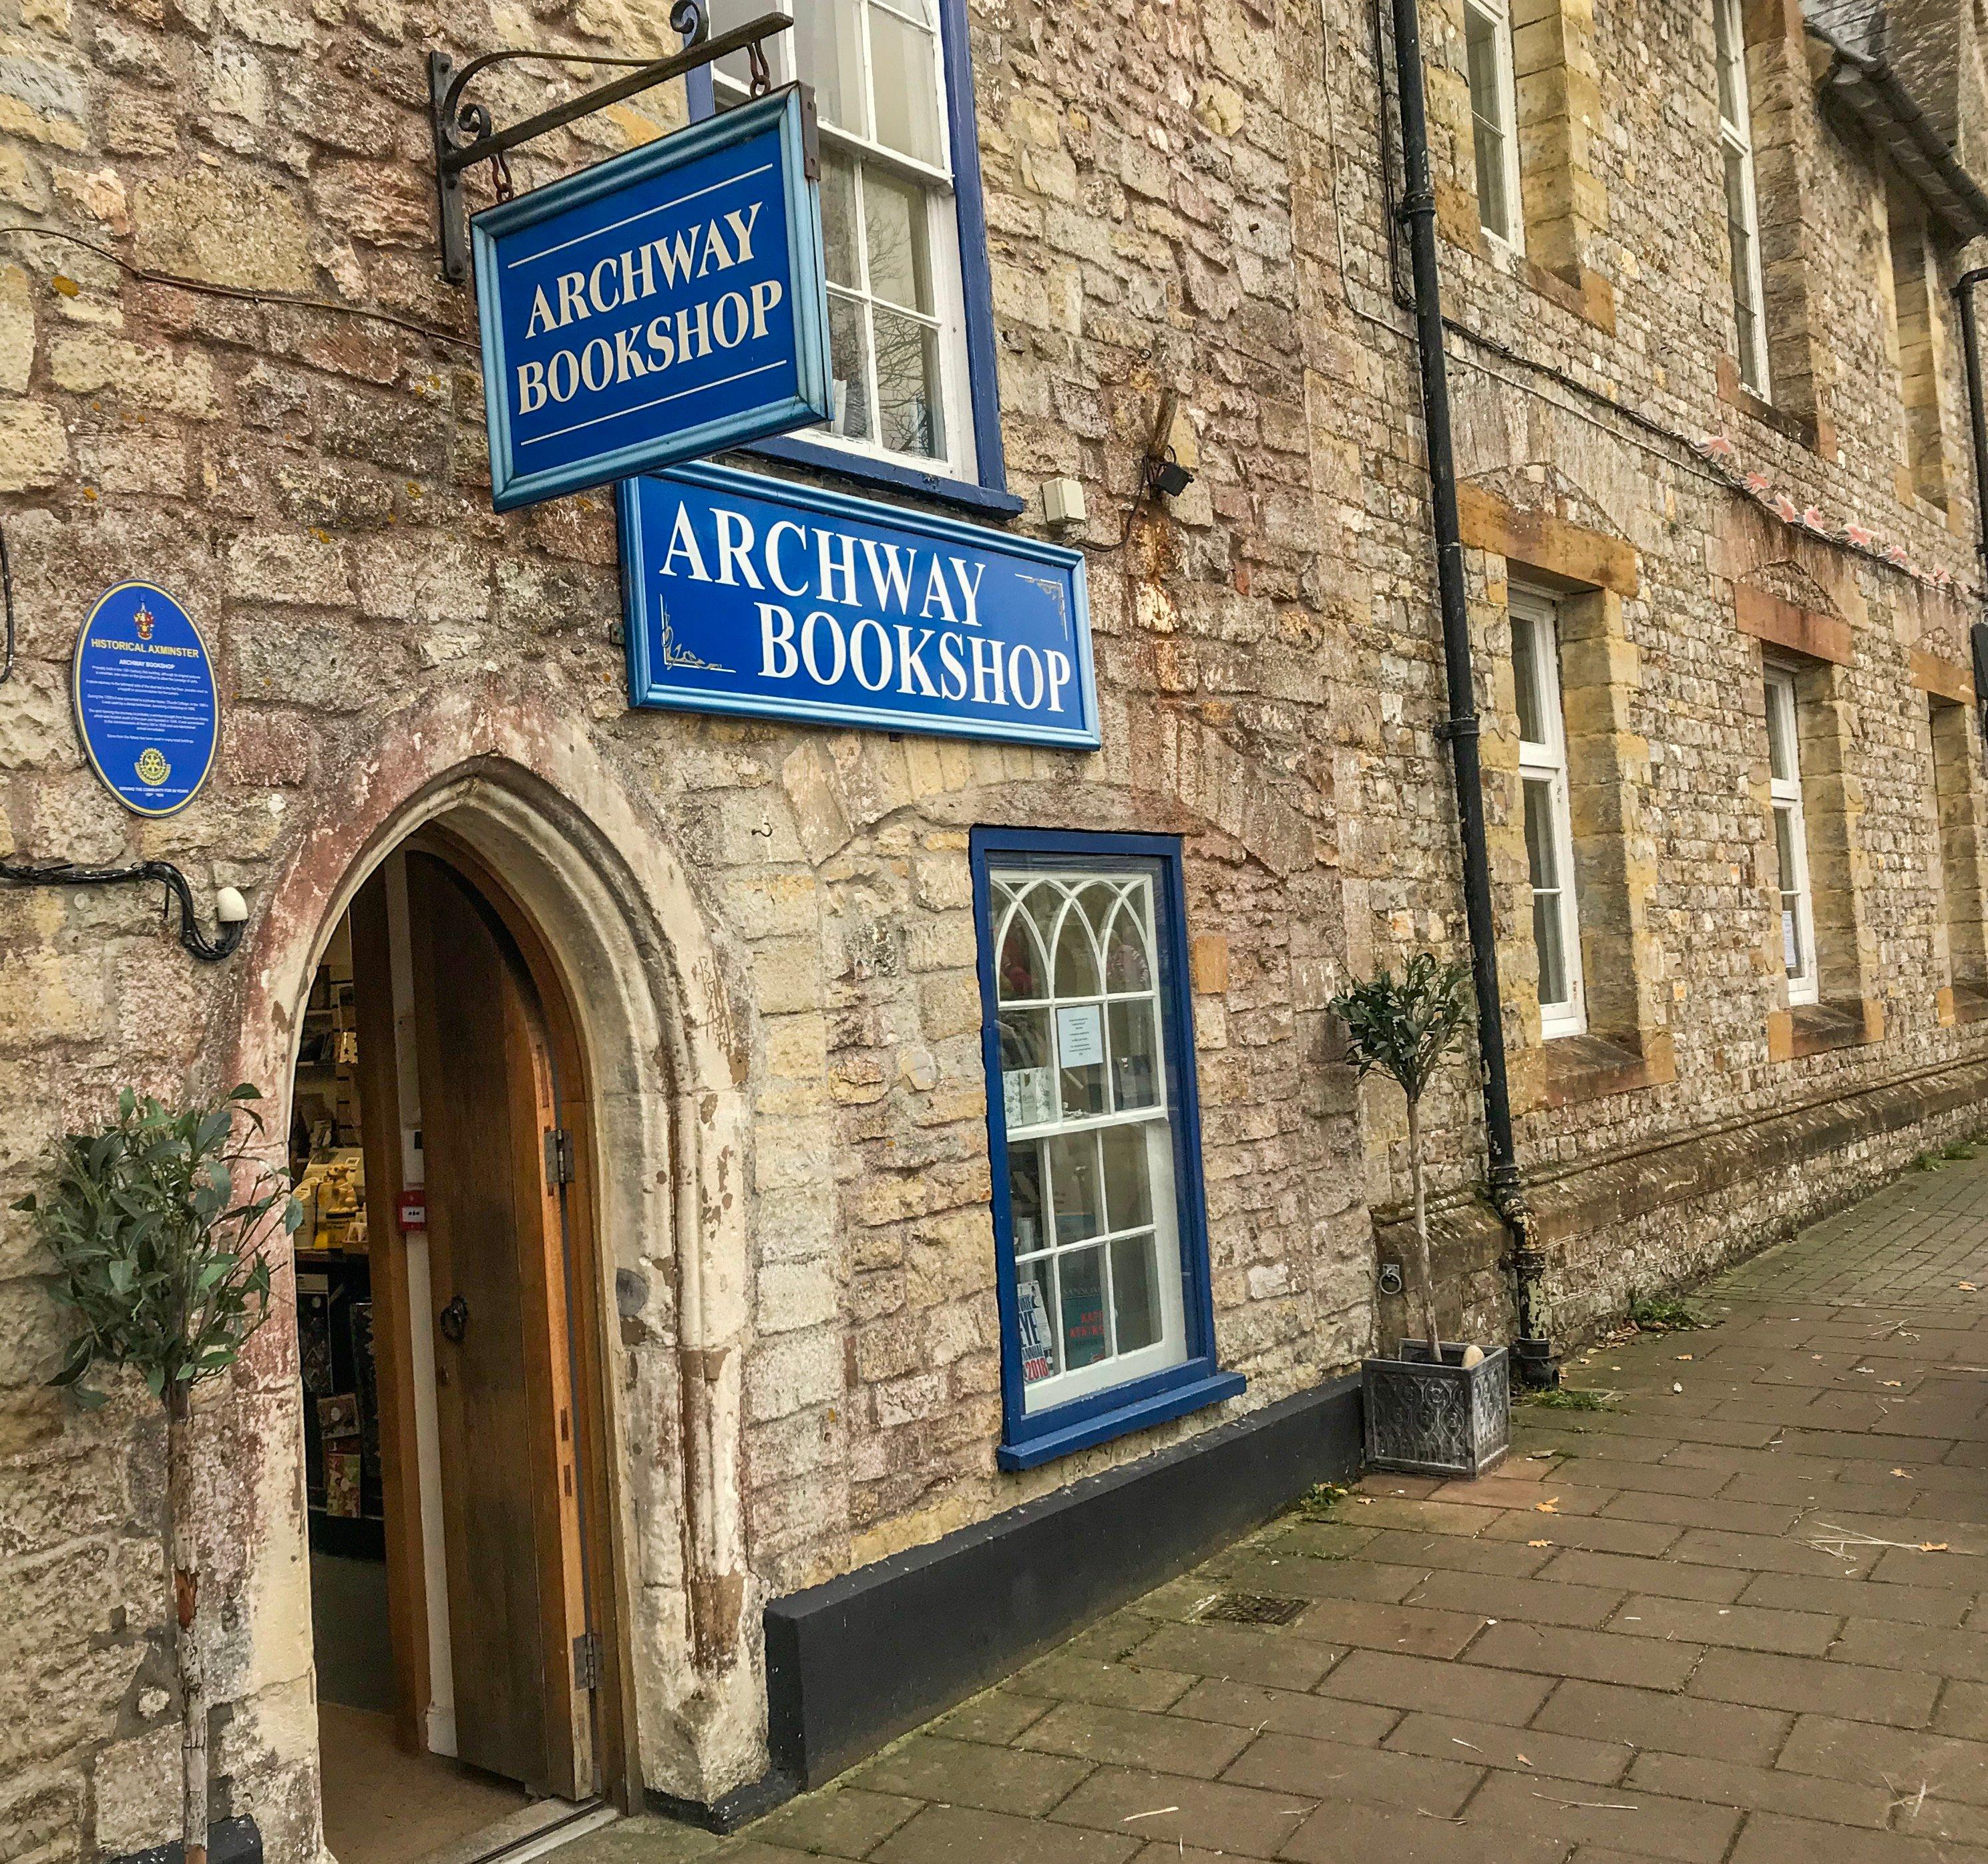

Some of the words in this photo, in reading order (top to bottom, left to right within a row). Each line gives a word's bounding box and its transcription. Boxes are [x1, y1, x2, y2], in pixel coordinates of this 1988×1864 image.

[526, 202, 762, 339] ARCHWAY
[517, 281, 782, 415] BOOKSHOP
[659, 502, 986, 626] ARCHWAY
[91, 638, 147, 653] HISTORICAL
[148, 644, 200, 659] AXMINSTER
[146, 661, 176, 670] BOOKSHOP
[754, 602, 1072, 712] BOOKSHOP
[1025, 1357, 1048, 1381] 2018
